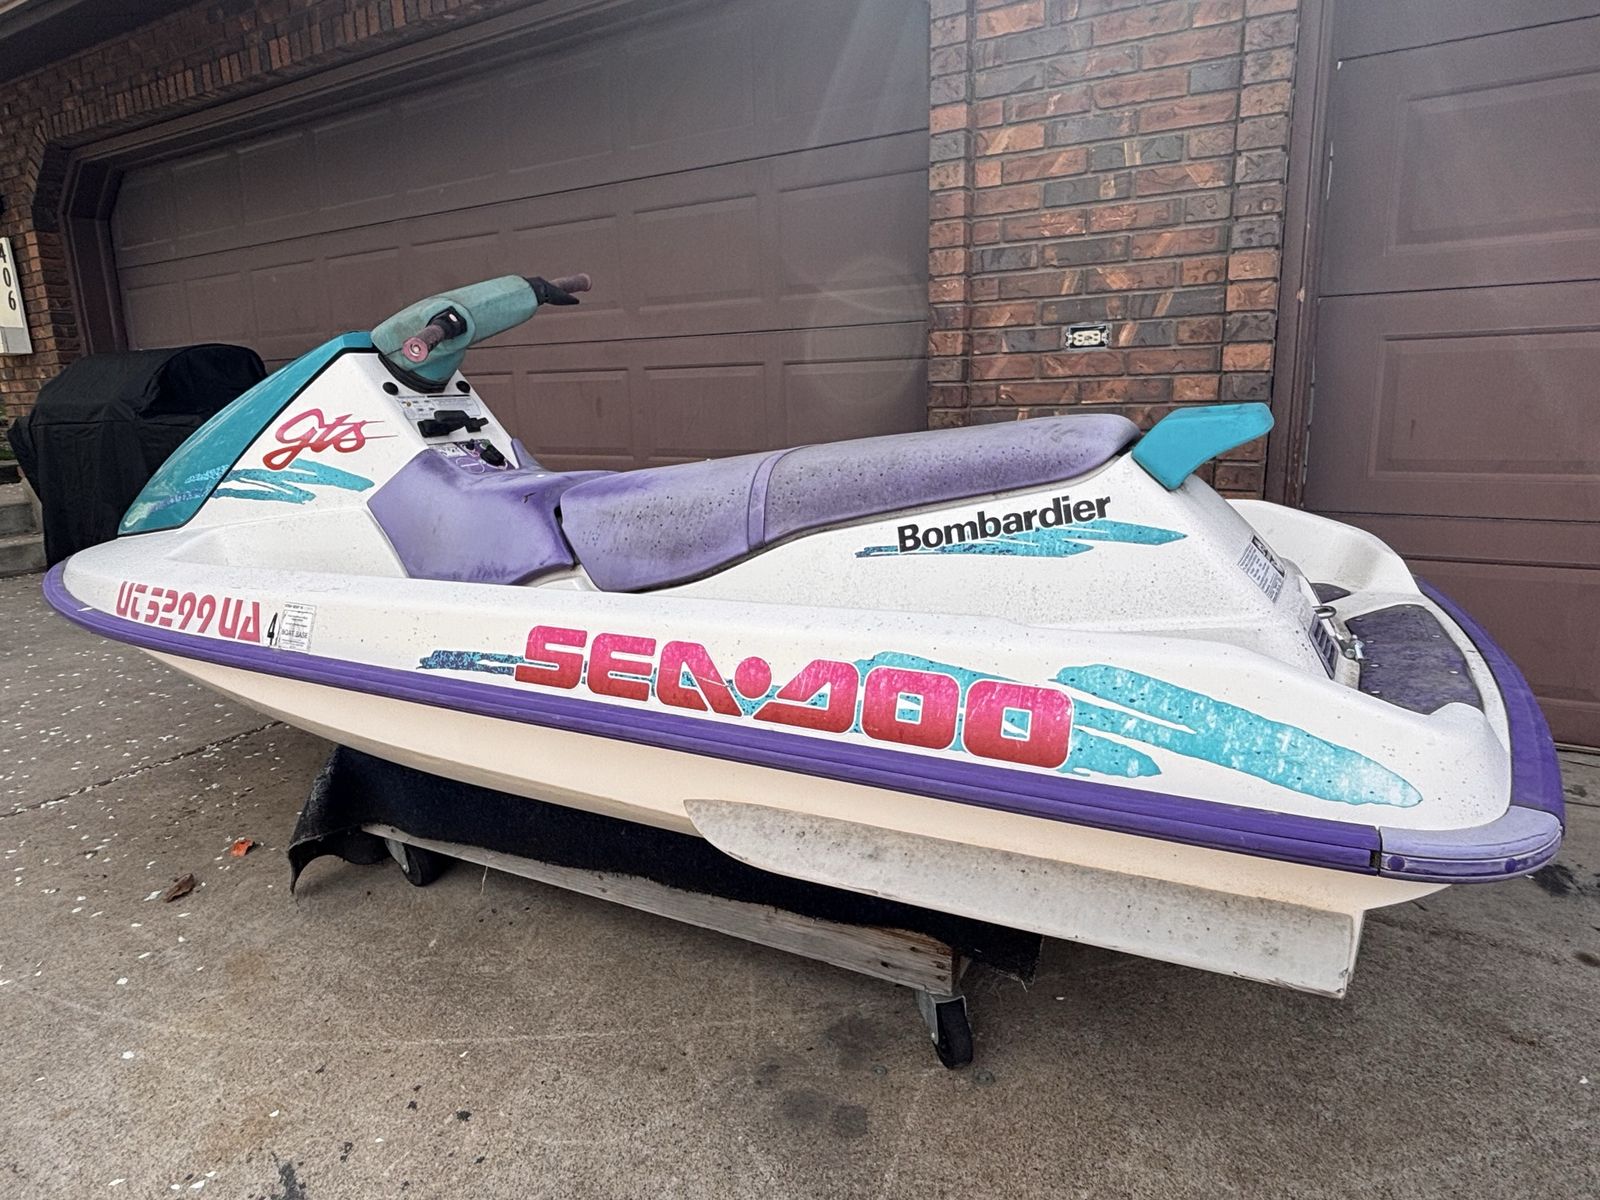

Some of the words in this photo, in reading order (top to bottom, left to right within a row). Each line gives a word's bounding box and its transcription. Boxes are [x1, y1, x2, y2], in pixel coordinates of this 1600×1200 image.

[897, 495, 1111, 553] Bombardier
[116, 581, 147, 621] UT
[145, 587, 217, 634] 5299
[218, 596, 261, 643] UA
